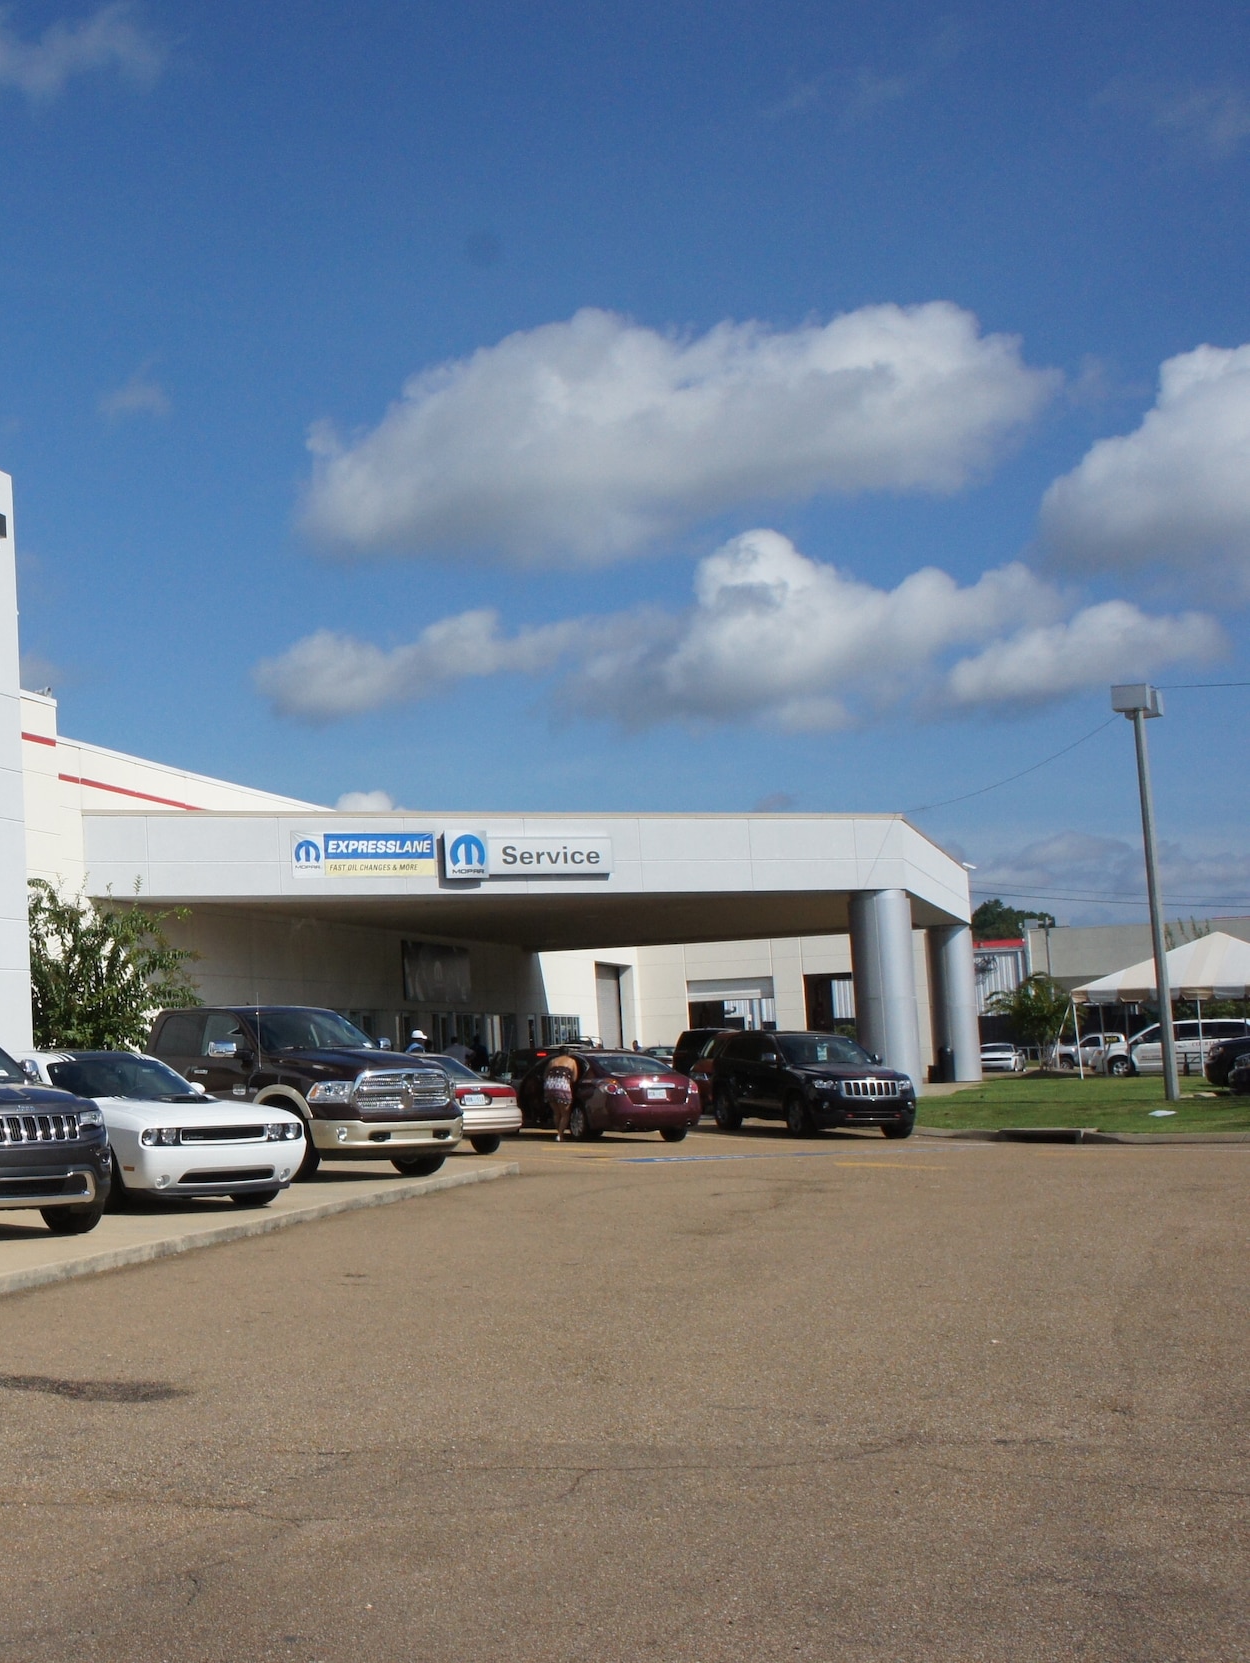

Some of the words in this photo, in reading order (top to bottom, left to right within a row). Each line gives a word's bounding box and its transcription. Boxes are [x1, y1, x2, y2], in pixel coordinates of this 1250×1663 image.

[501, 845, 600, 865] Service
[329, 863, 346, 872] FAST
[347, 863, 358, 872] OIL
[359, 863, 391, 872] CHANGES
[399, 863, 419, 872] MORE
